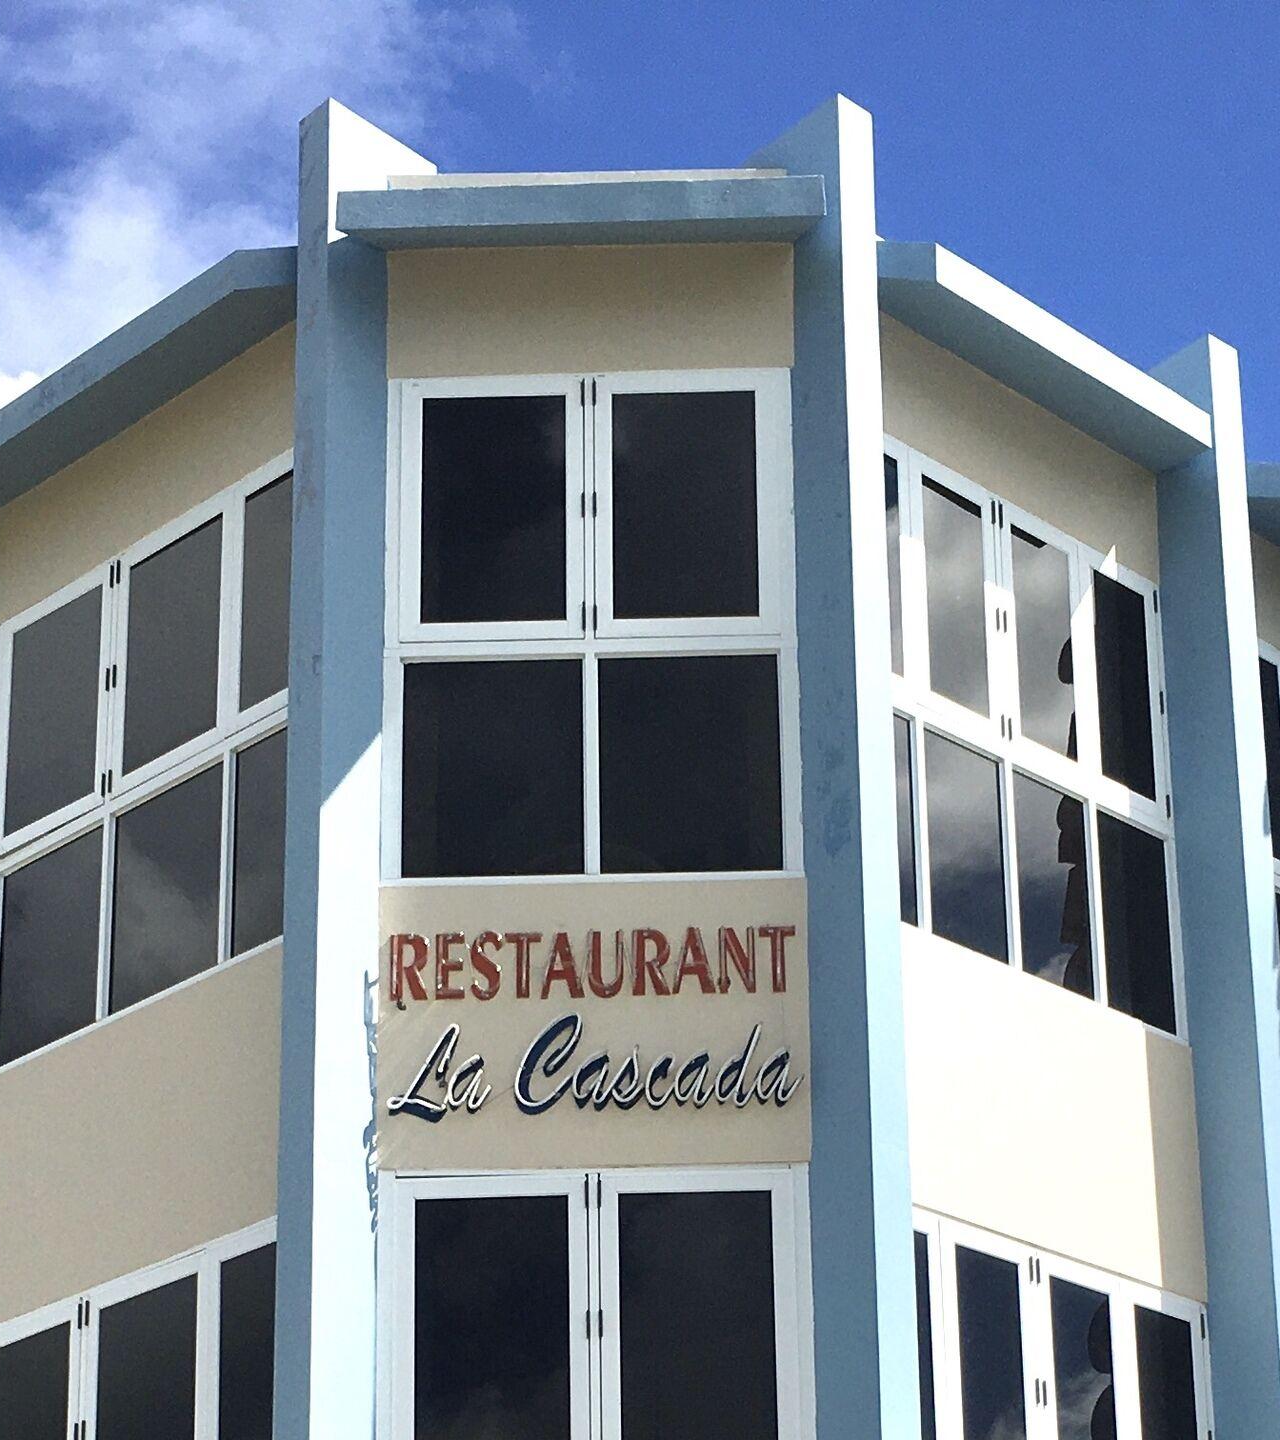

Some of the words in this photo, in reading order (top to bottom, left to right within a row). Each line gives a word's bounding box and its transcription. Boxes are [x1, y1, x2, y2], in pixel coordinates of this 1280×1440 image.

[387, 924, 797, 1003] RESTAURANT
[387, 1023, 492, 1123] La
[514, 1010, 806, 1116] Cascada
